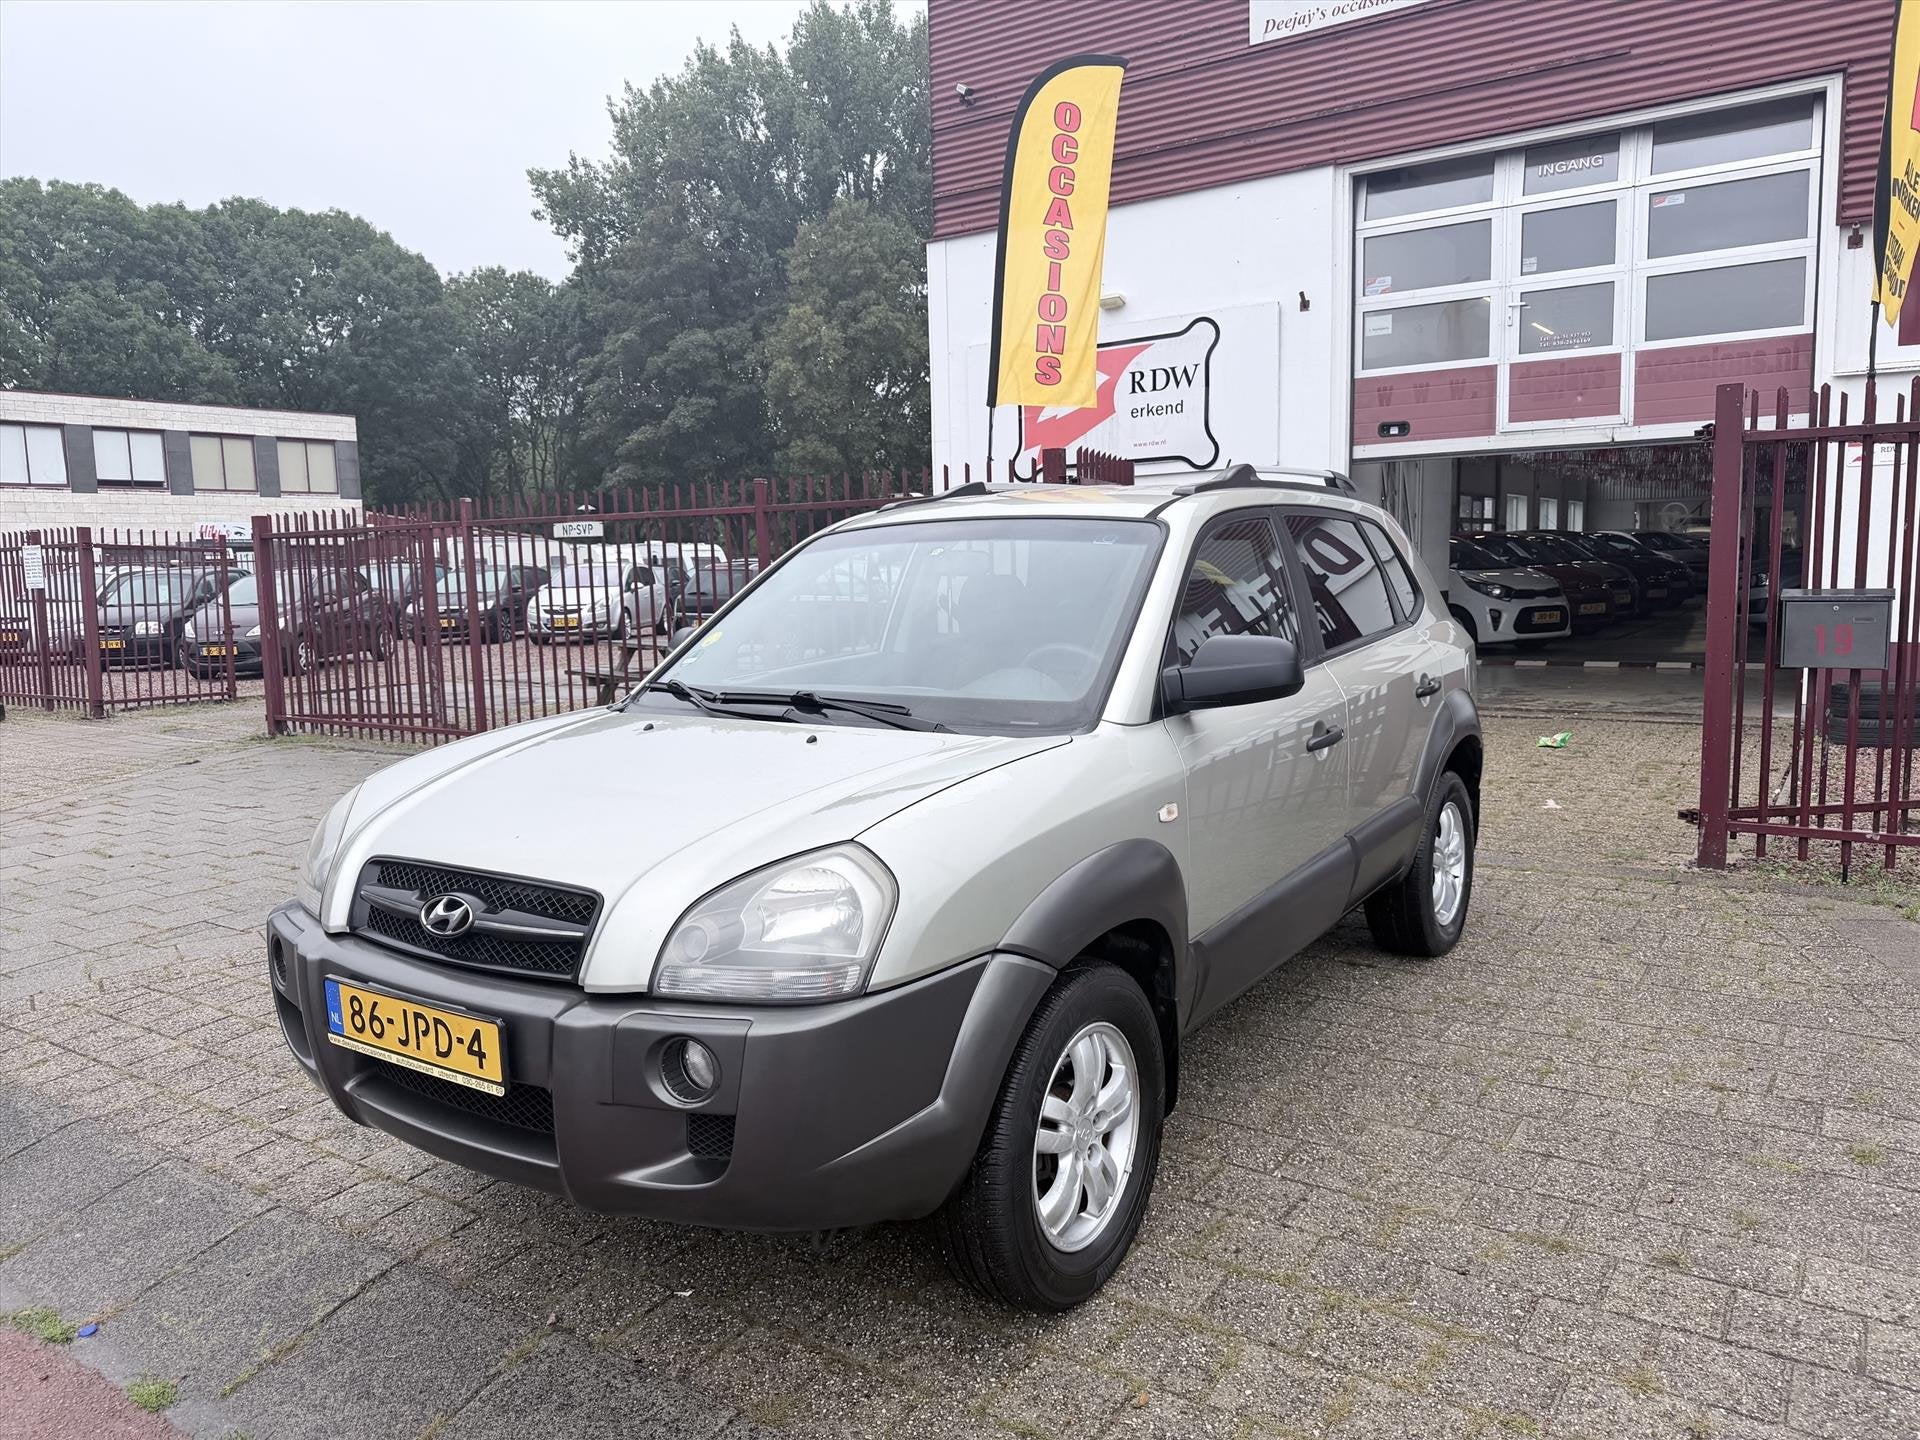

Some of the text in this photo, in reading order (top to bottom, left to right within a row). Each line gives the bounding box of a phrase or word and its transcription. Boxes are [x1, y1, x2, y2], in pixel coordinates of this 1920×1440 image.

[1263, 7, 1327, 34] Deejay's
[1537, 154, 1604, 177] INGANG
[1034, 101, 1082, 386] OCCASIONS
[1128, 363, 1201, 395] RDW
[1130, 400, 1184, 419] erkend
[1814, 624, 1854, 656] 19
[330, 1011, 342, 1025] NL
[349, 995, 487, 1070] 86-JPD-4
